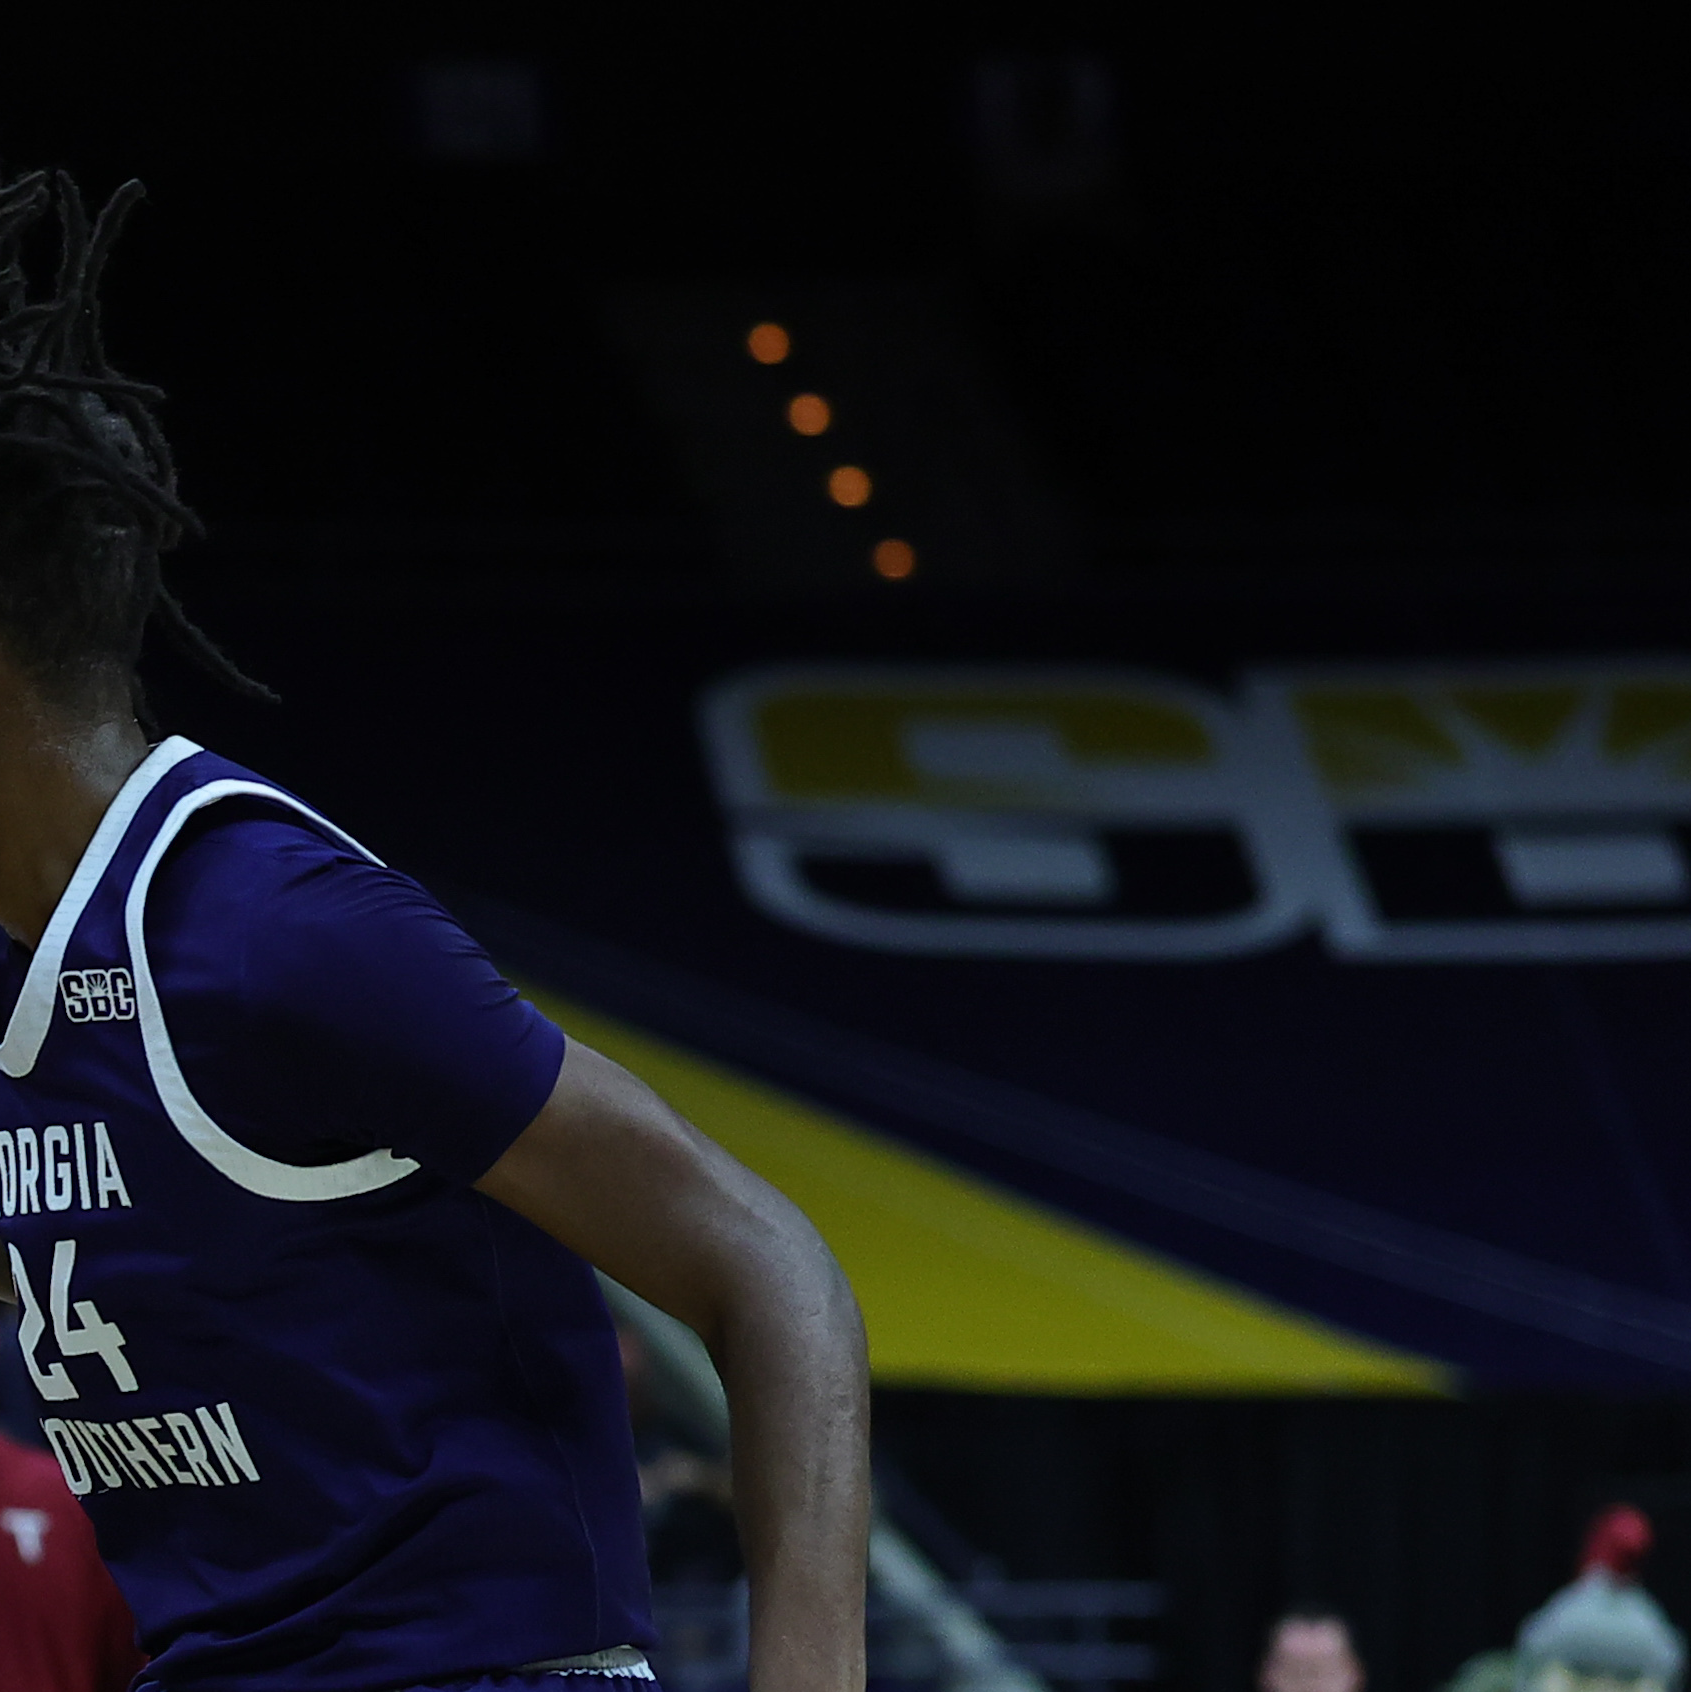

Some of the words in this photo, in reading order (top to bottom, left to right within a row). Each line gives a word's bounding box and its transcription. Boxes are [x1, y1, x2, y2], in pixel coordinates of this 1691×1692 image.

[58, 967, 136, 1023] SBC
[7, 1239, 139, 1401] 24
[39, 1401, 262, 1501] OUTHERN
